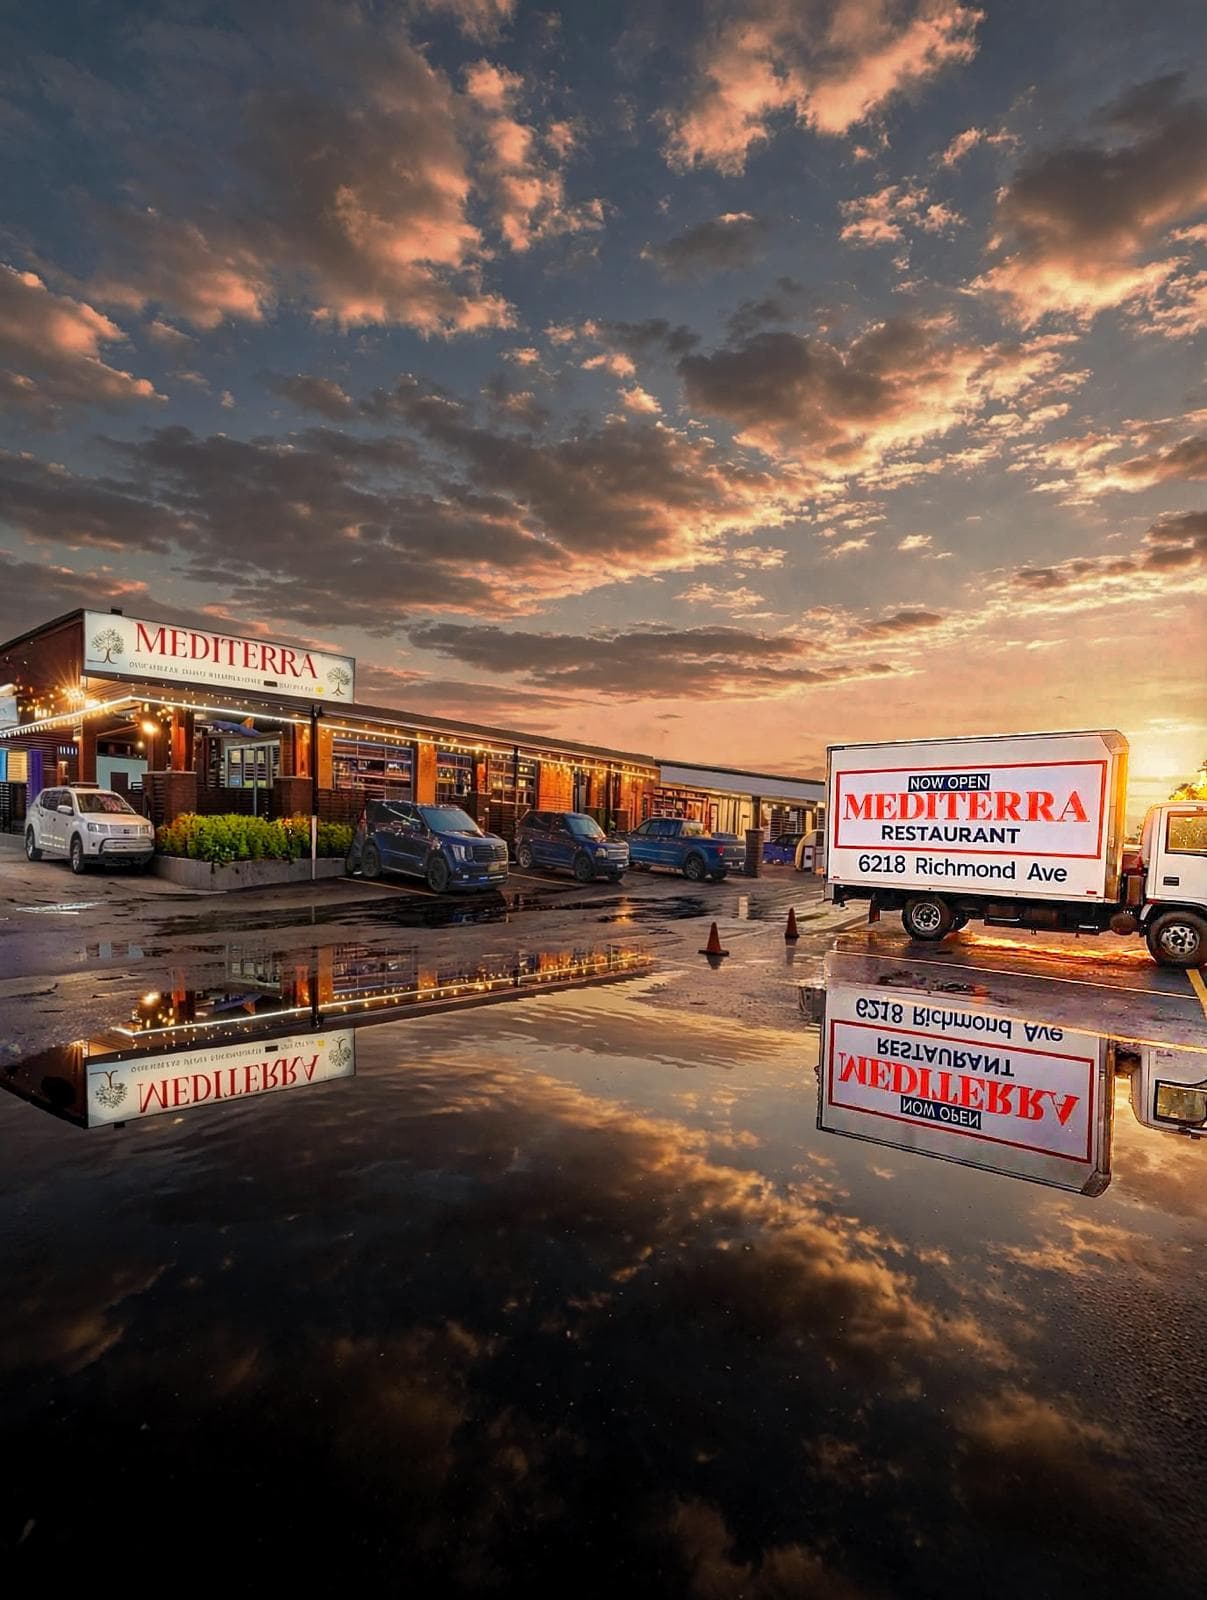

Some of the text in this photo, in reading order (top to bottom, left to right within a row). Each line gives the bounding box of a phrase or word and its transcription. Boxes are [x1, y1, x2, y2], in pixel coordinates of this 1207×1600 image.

[135, 622, 318, 679] MEDITERRA
[910, 774, 989, 791] NOW OPEN
[842, 790, 1090, 823] MEDITERRA
[881, 824, 1021, 844] RESTAURANT
[858, 854, 1068, 883] 6218 Richmond Ave
